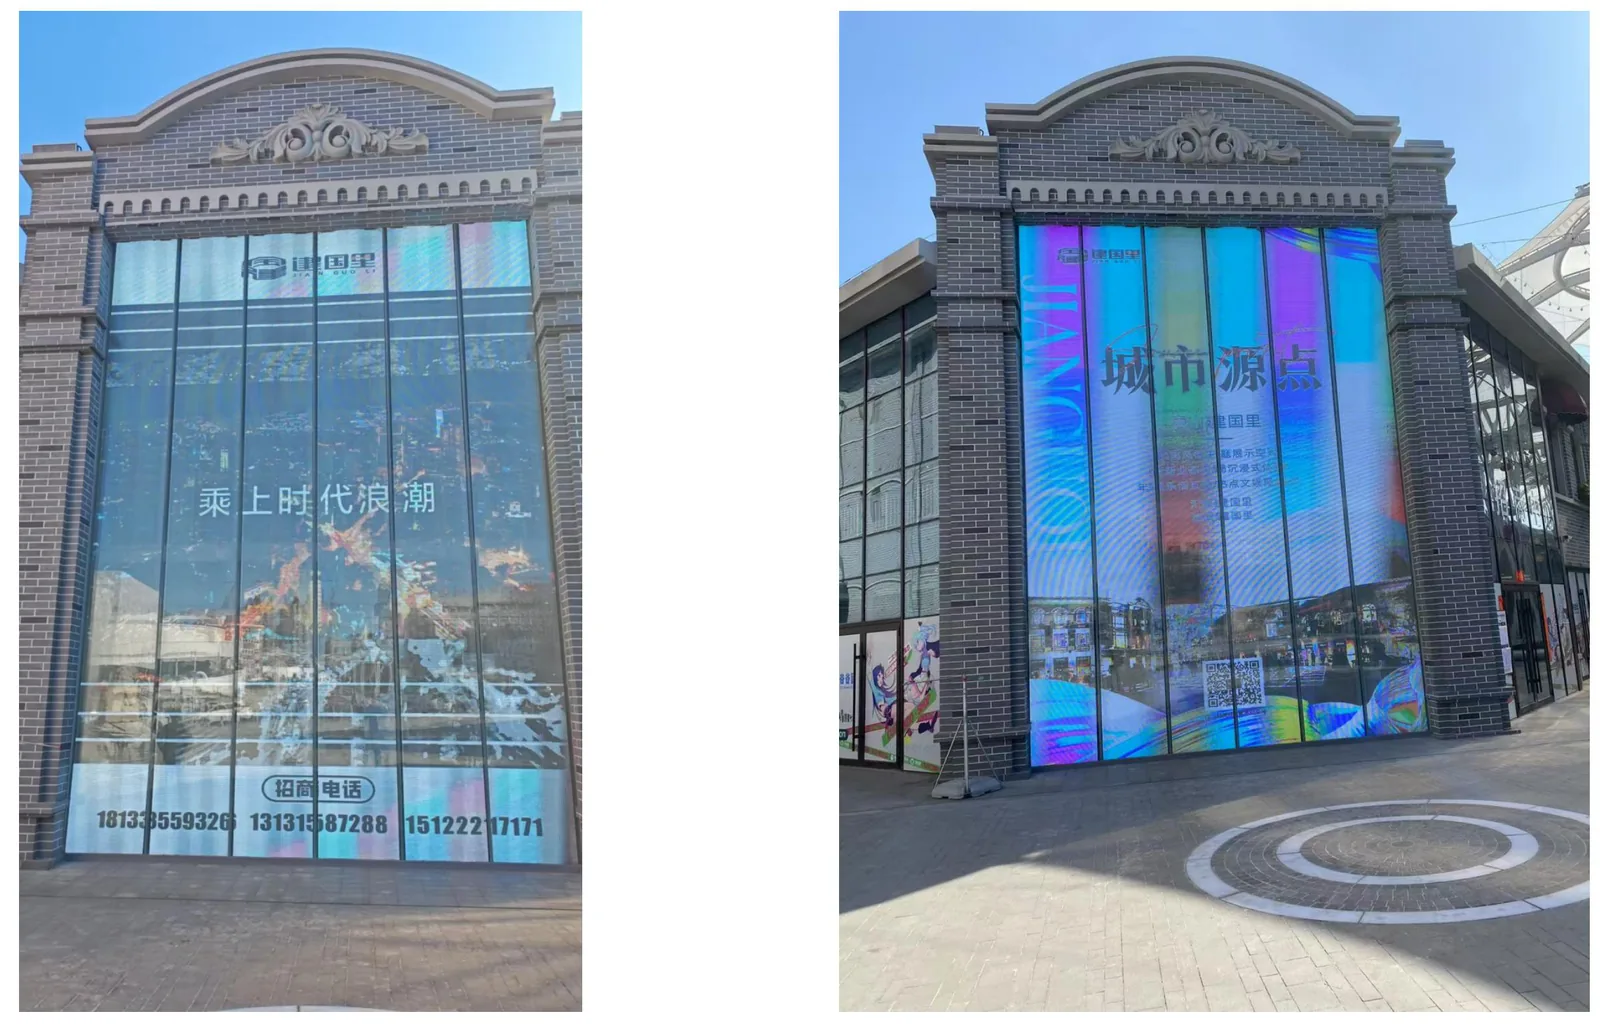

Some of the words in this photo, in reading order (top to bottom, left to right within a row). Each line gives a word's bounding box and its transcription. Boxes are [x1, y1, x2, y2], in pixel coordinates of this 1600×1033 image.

[292, 252, 376, 273] 建国里
[1101, 344, 1323, 396] 城市源点
[199, 482, 435, 518] 乘上时代浪潮
[274, 779, 362, 800] 招商电话
[249, 812, 388, 834] 13131587288
[405, 815, 544, 837] 15122217171
